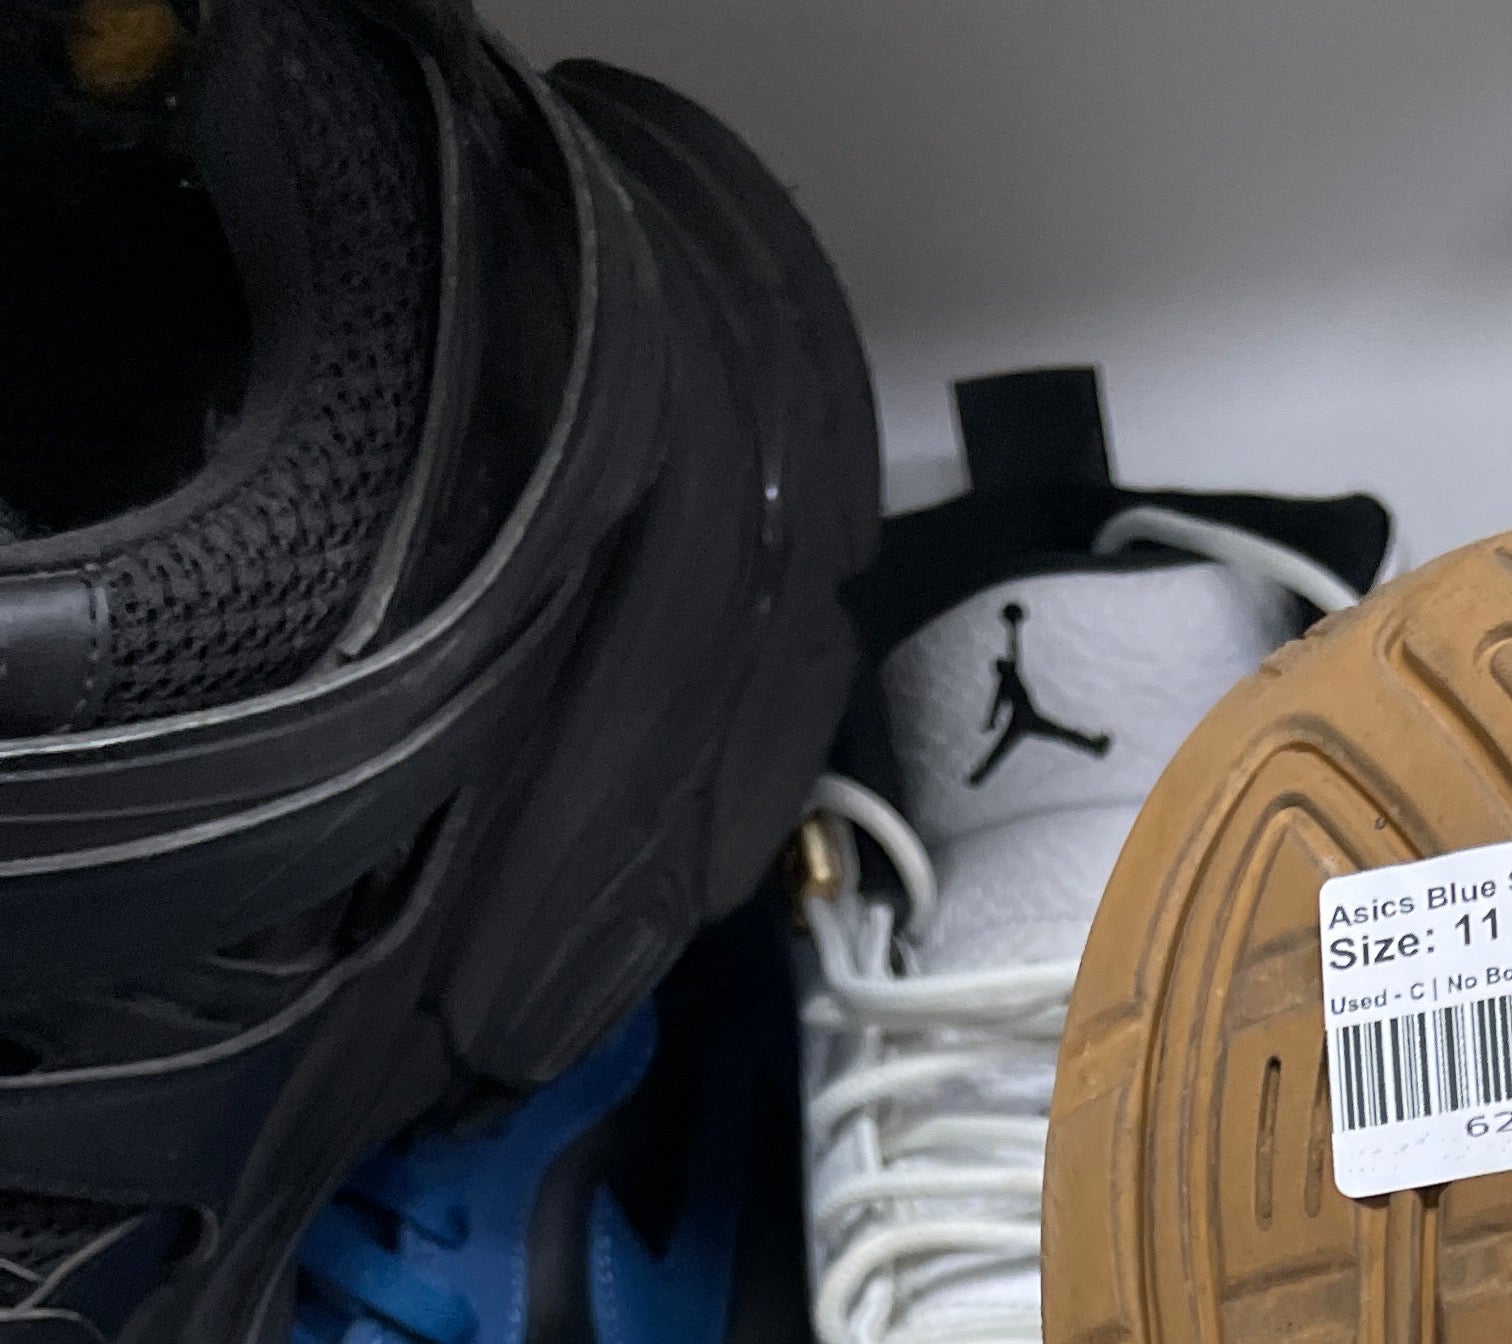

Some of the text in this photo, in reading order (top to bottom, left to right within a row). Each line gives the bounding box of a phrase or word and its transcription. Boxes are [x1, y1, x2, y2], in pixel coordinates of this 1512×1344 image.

[1328, 897, 1416, 929] Asics
[1427, 880, 1497, 910] Blue
[1329, 907, 1502, 971] Size: 11
[1330, 988, 1388, 1016] Used
[1410, 982, 1426, 1001] C
[1448, 974, 1479, 992] No
